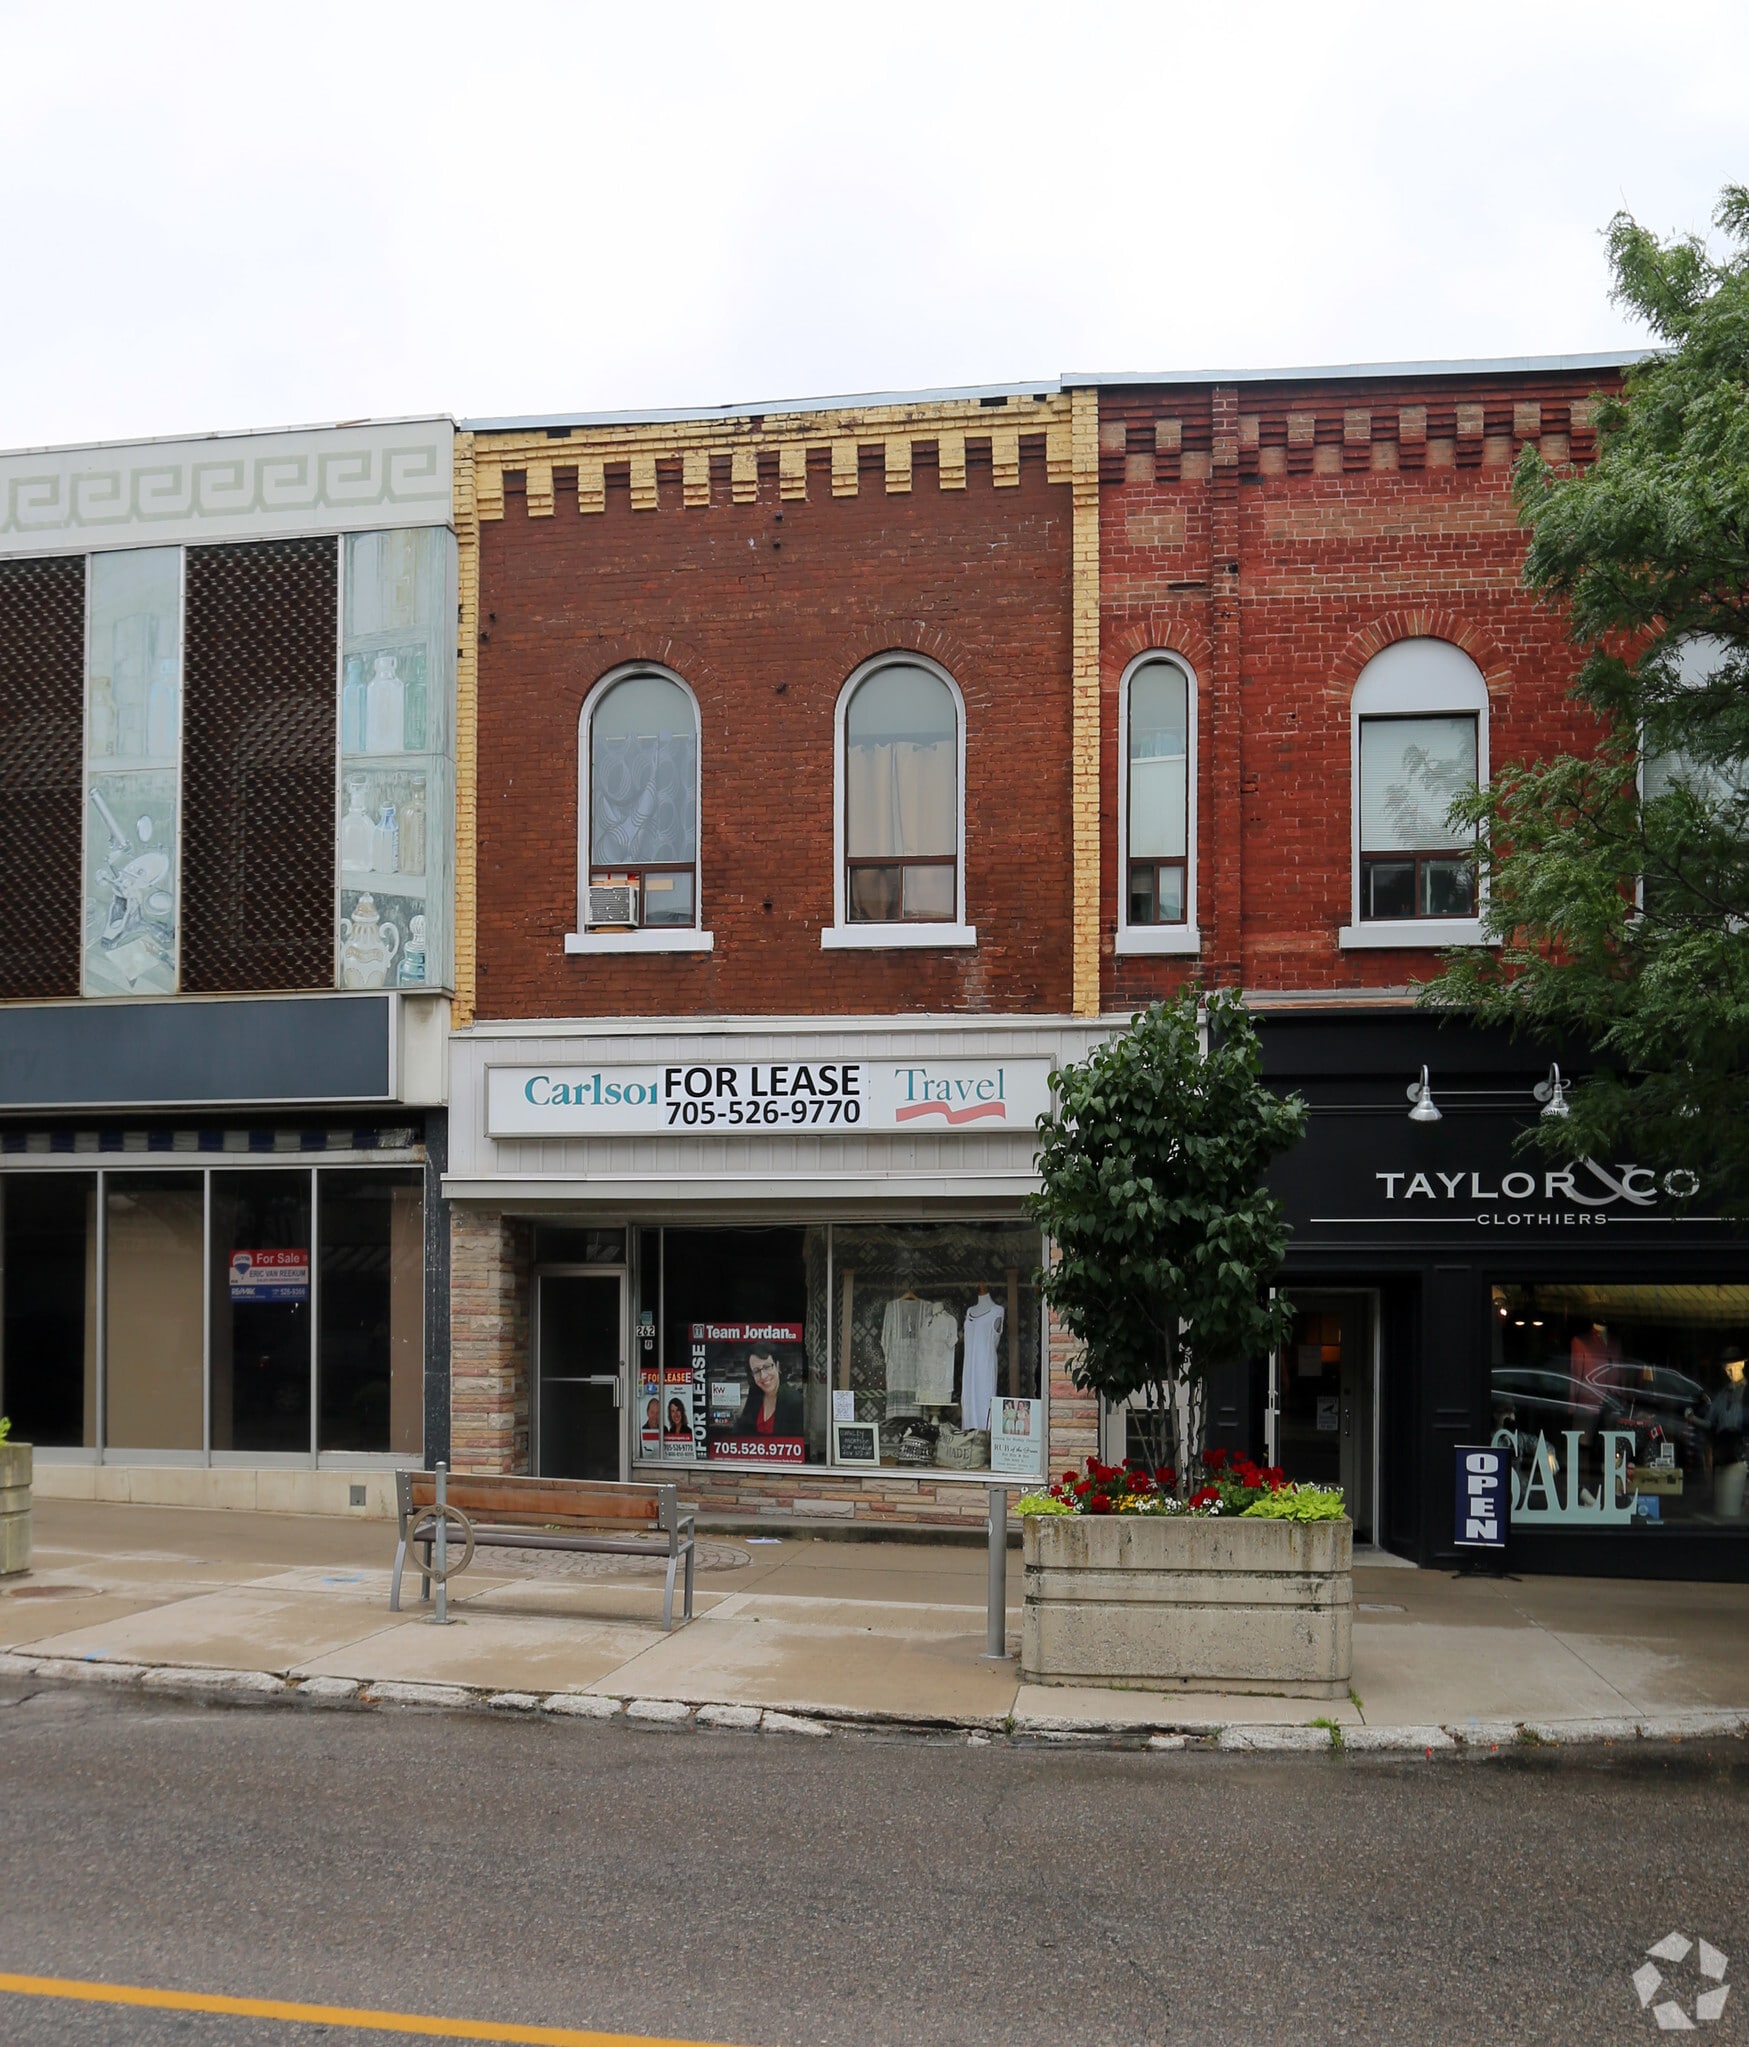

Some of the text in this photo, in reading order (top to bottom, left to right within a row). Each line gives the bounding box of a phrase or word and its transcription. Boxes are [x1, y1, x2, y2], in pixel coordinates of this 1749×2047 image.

[664, 1065, 861, 1099] FOR LEASE
[895, 1068, 1007, 1102] Travel
[666, 1100, 861, 1126] 705-526-9770
[1476, 1212, 1608, 1226] CLOTHIERS
[256, 1253, 275, 1264] For
[278, 1253, 300, 1264] Sale
[637, 1326, 655, 1336] 262
[706, 1324, 741, 1339] Team
[692, 1344, 706, 1407] LEASE
[693, 1411, 707, 1451] FOR
[713, 1441, 803, 1457] 705.526.9770
[1465, 1453, 1499, 1540] OPEN
